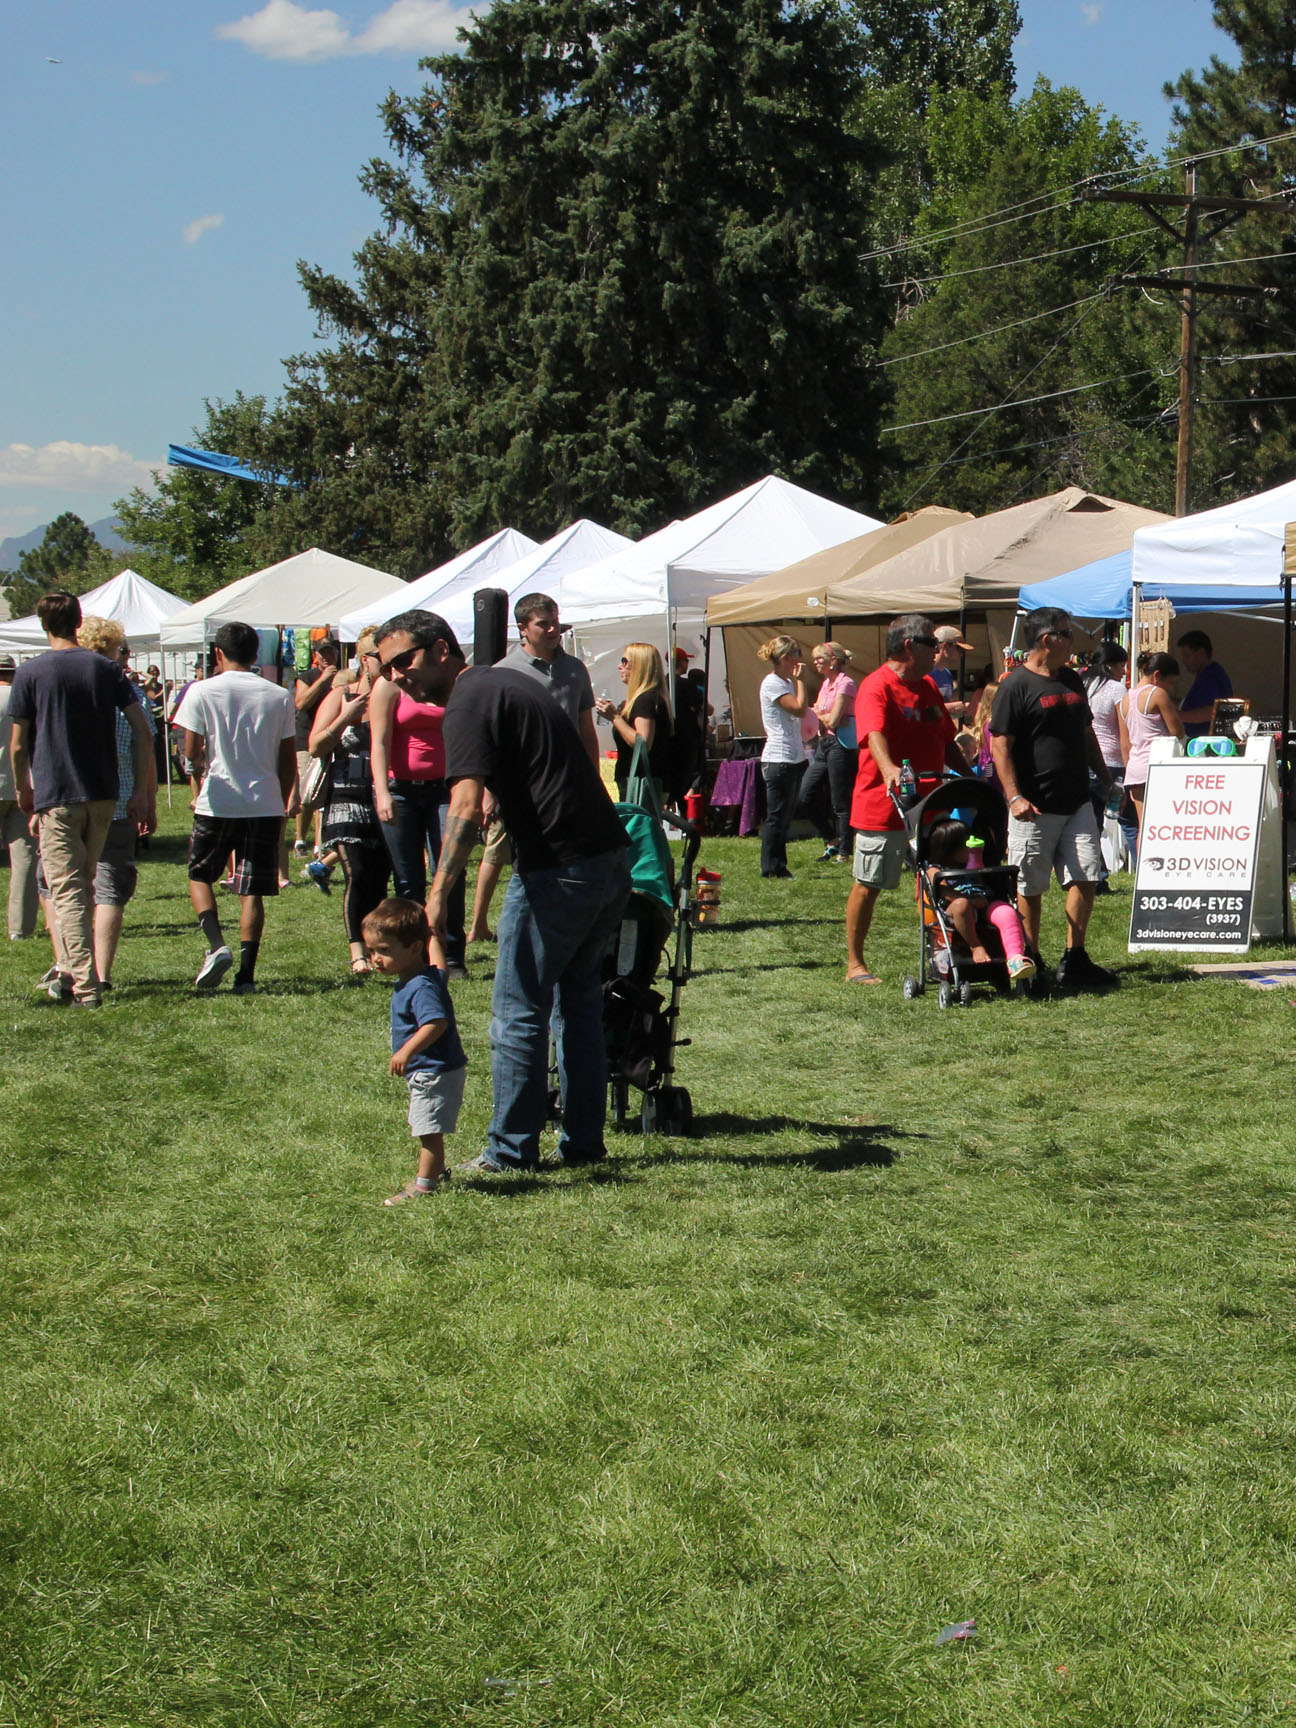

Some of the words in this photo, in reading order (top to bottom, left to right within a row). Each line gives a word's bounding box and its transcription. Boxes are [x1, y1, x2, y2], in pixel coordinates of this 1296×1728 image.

[1185, 775, 1226, 790] FREE
[1172, 800, 1232, 815] VISION
[1147, 825, 1251, 841] SCREENING
[1140, 896, 1244, 911] 303-404-EYES
[1206, 913, 1241, 926] (3937)
[1136, 929, 1242, 940] 3dvisioneyecare.com
